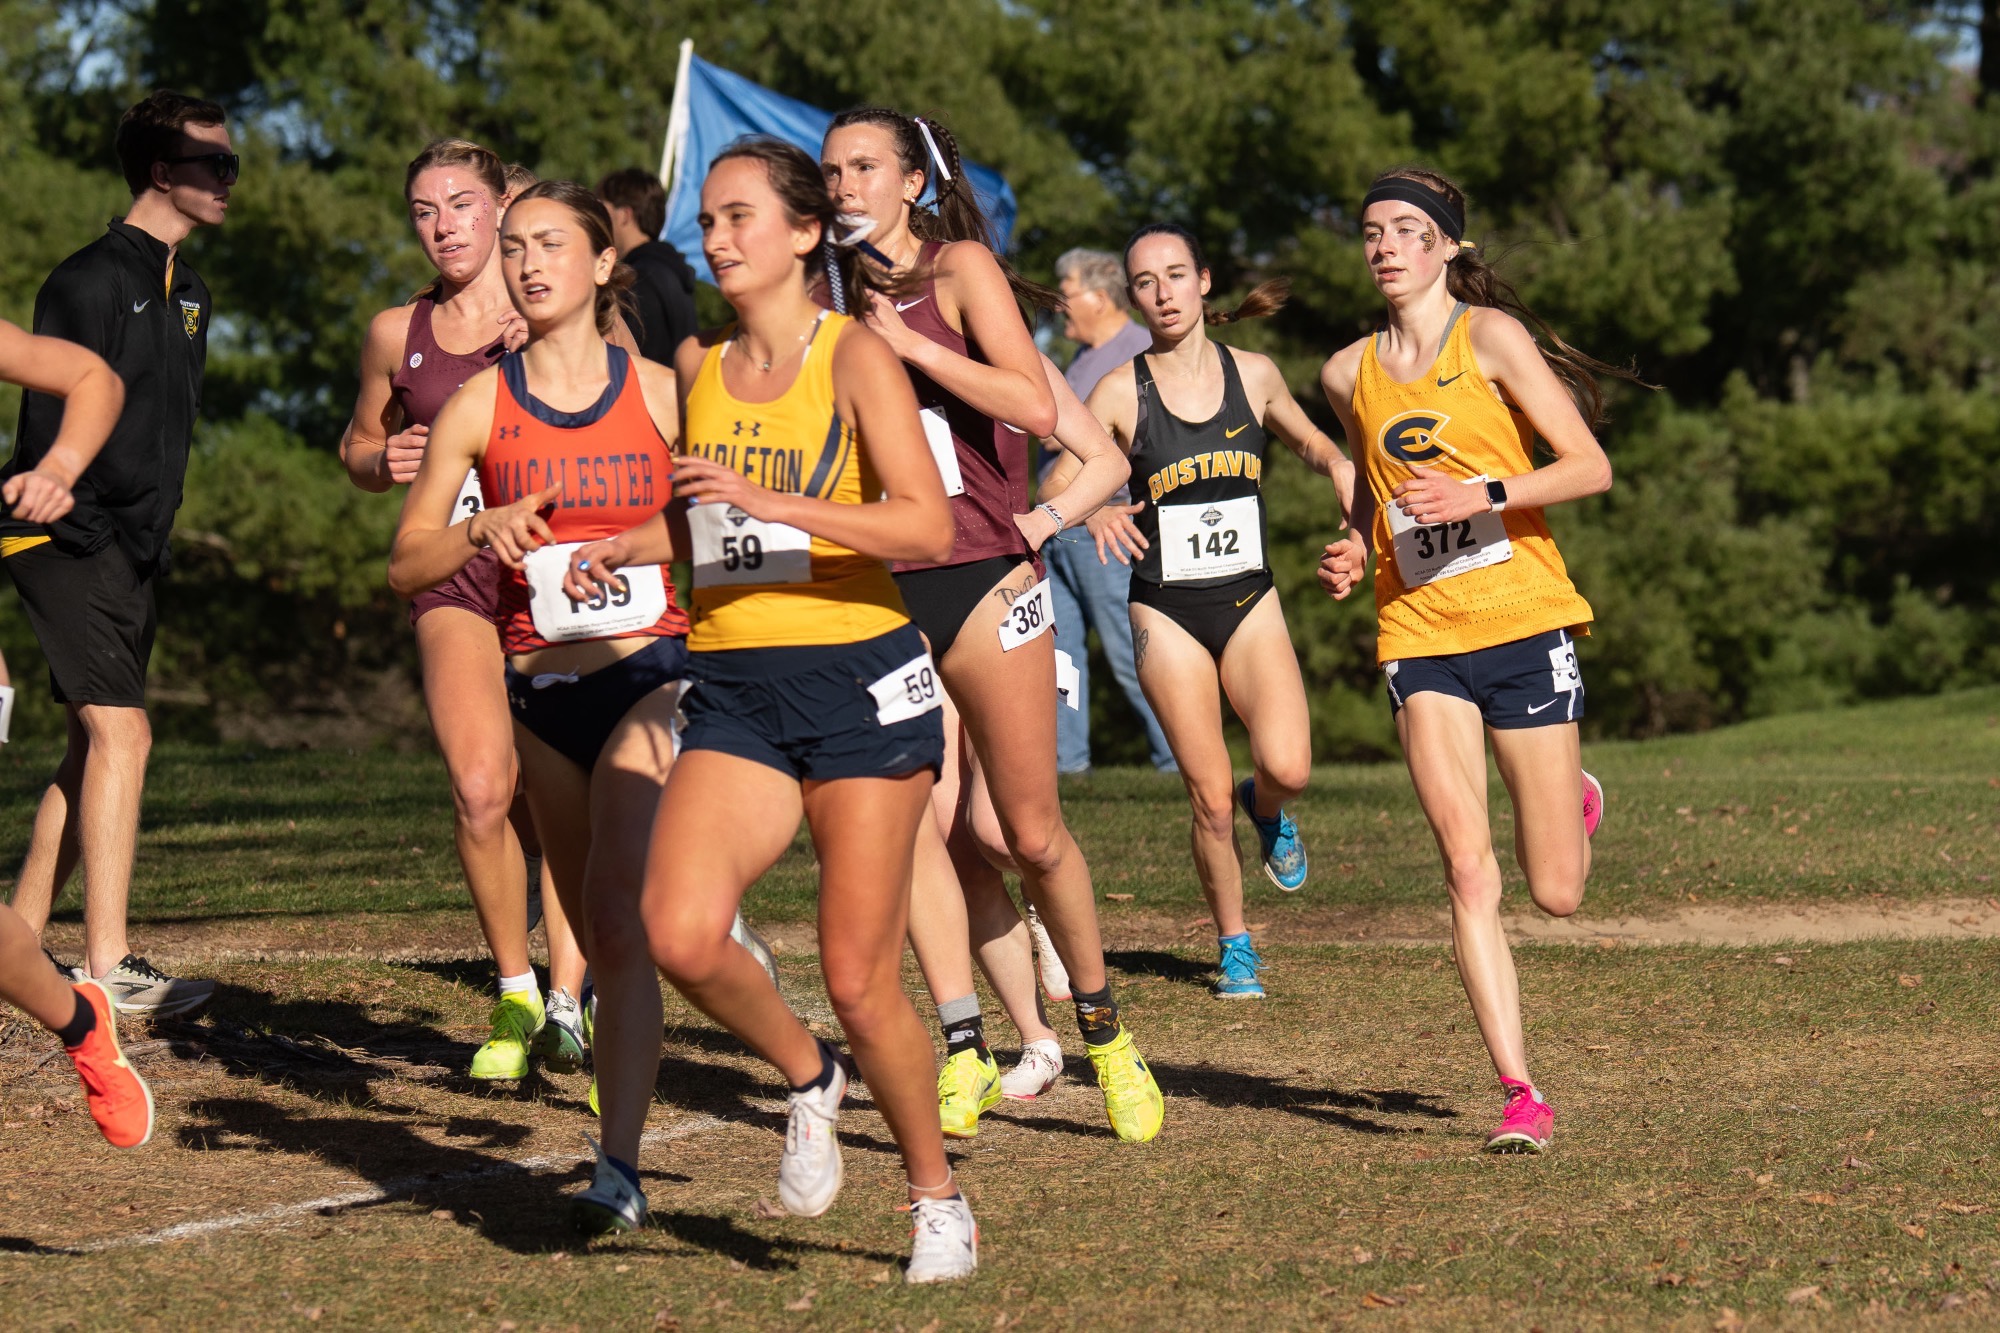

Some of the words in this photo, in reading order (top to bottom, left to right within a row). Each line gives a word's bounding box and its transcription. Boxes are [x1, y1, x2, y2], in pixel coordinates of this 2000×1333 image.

[722, 534, 764, 572] 59
[1187, 529, 1240, 559] 142
[1413, 519, 1478, 560] 372
[1012, 591, 1045, 635] 387
[903, 667, 935, 704] 59
